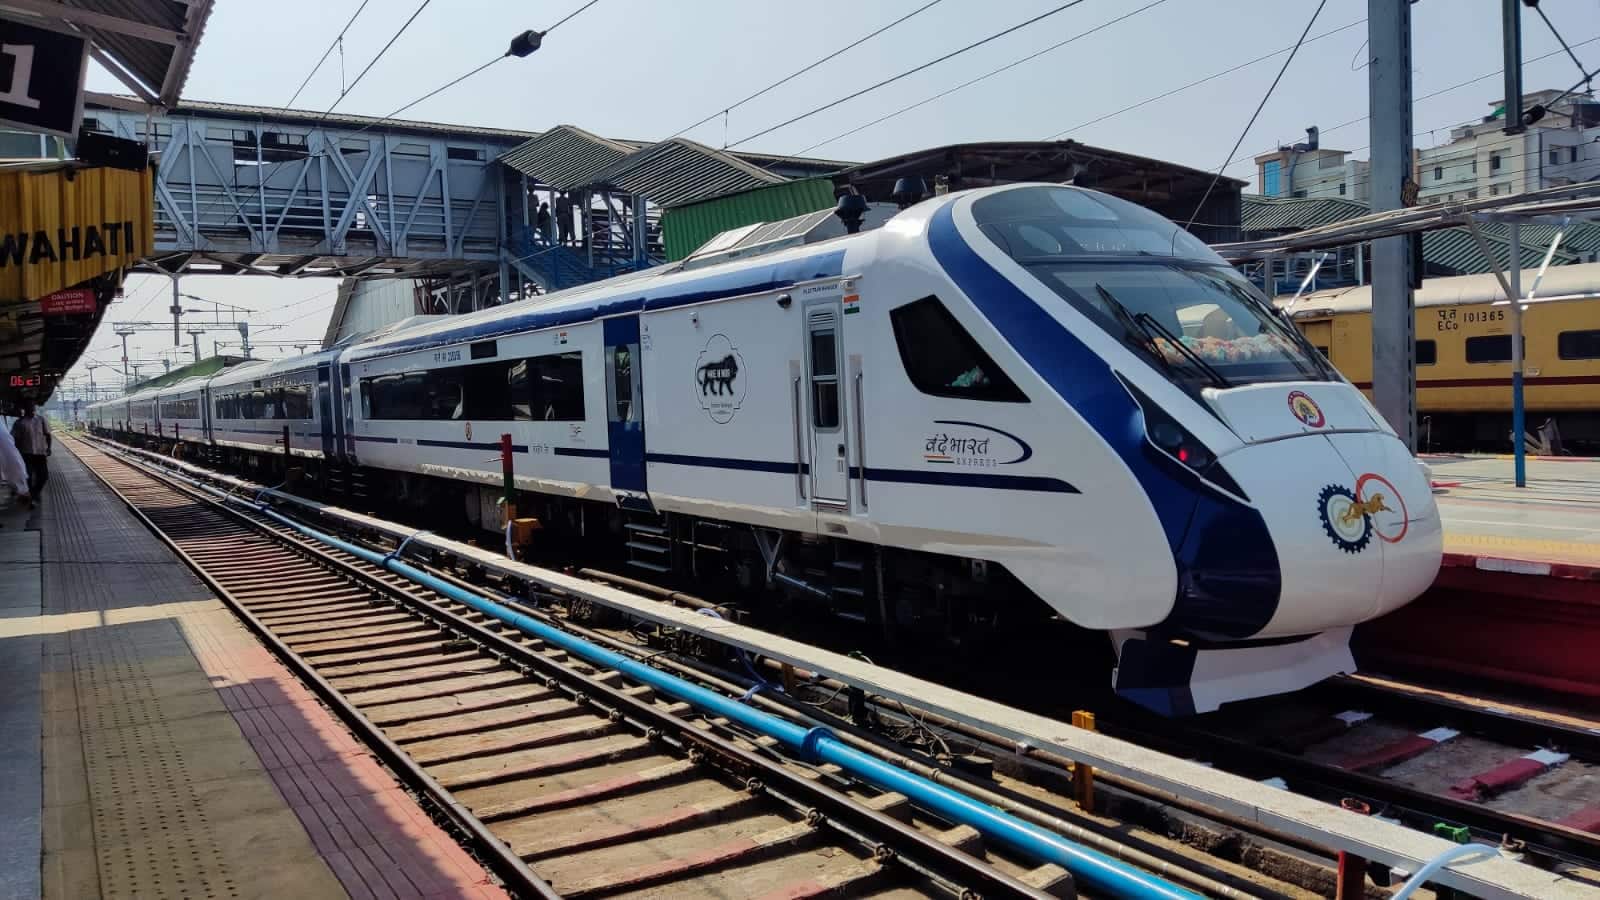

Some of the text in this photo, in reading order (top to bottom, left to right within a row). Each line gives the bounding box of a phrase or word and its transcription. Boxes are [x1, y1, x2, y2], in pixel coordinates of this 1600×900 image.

[0, 43, 40, 109] 1
[51, 292, 84, 300] CAUTION
[1463, 310, 1504, 323] 101365
[1438, 320, 1458, 331] ECo
[956, 458, 997, 467] EXPRESS
